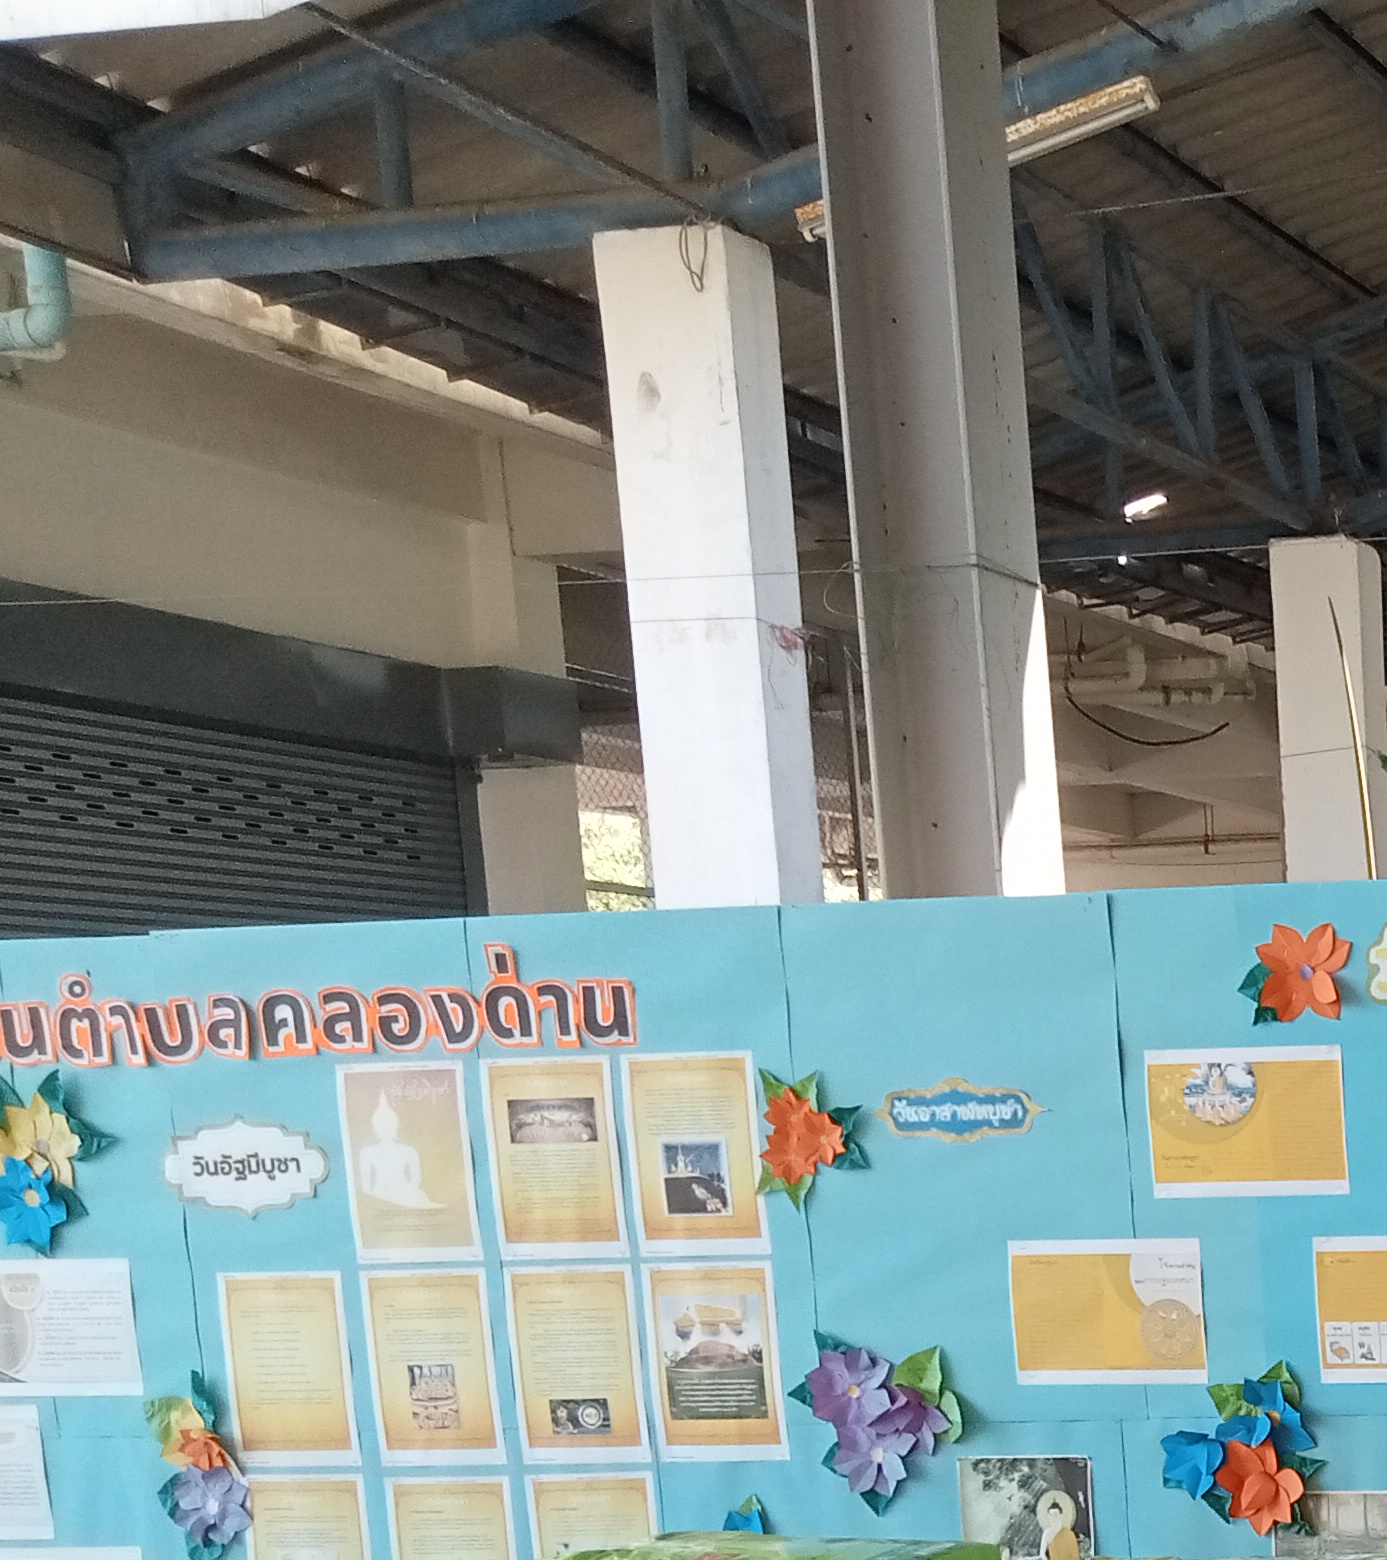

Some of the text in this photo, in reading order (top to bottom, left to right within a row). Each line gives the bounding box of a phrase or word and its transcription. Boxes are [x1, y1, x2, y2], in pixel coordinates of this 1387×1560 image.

[191, 1149, 302, 1182] วันอัฐมีบูชา
